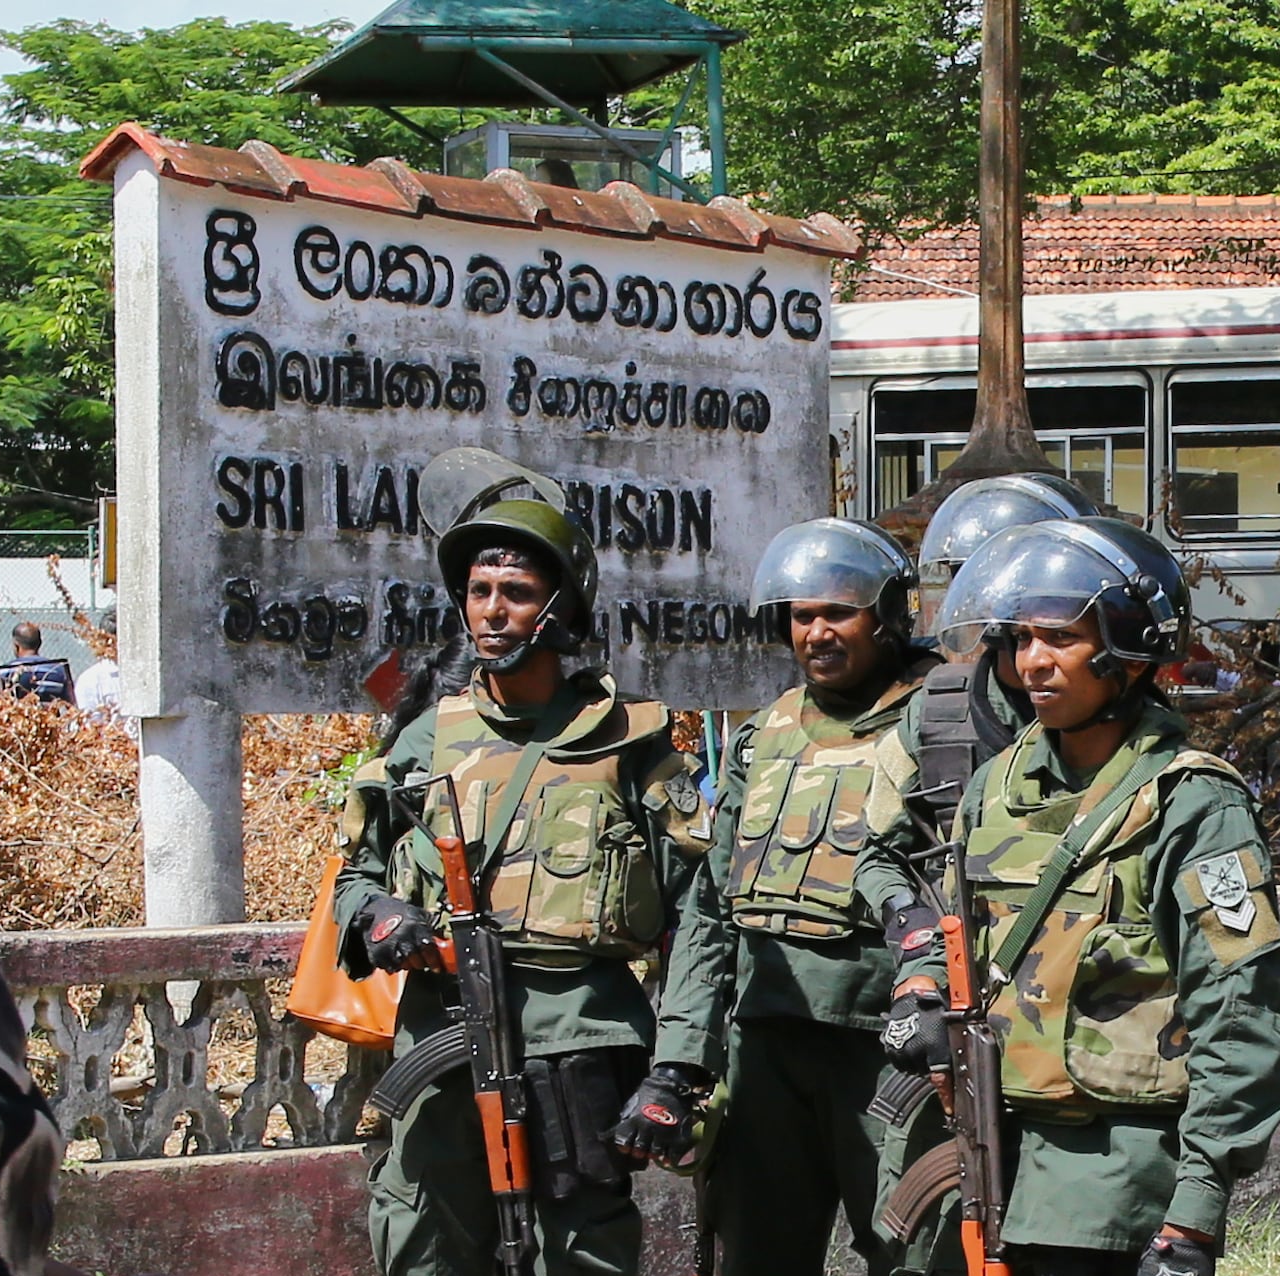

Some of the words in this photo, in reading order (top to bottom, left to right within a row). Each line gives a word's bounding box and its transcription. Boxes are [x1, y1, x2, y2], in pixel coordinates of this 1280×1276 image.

[294, 225, 454, 308] ලංකා
[216, 331, 486, 413] இலங்கை
[217, 456, 304, 531] SRI
